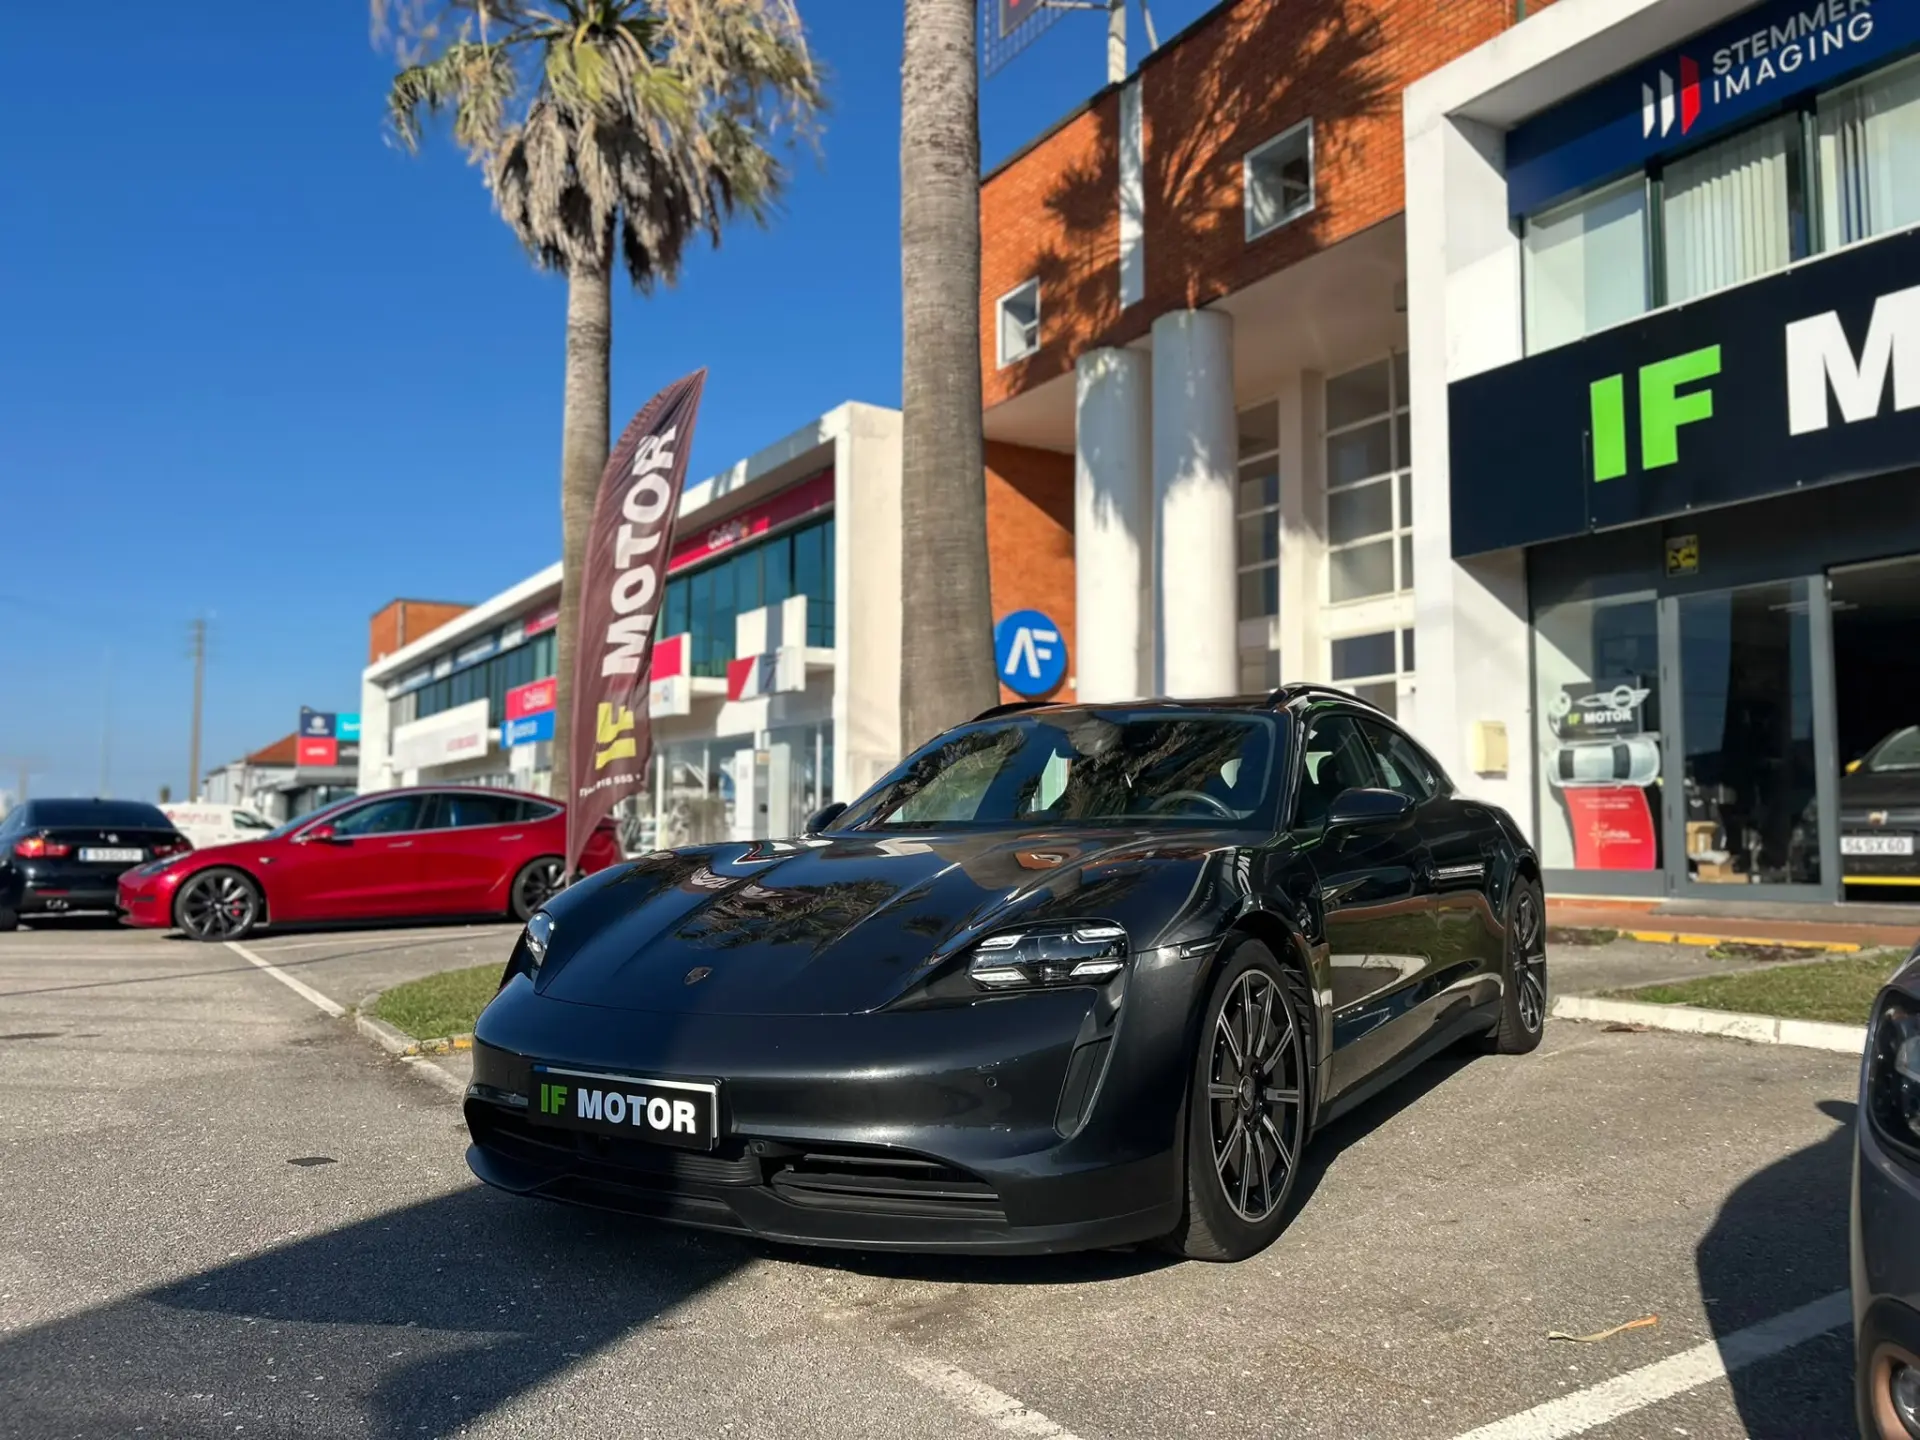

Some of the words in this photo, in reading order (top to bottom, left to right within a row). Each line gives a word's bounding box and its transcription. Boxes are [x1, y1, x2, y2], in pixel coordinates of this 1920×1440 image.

[1713, 12, 1874, 104] IMAGING
[1590, 344, 1722, 482] IF
[601, 424, 677, 677] MOTOR
[1004, 626, 1058, 679] AF
[595, 702, 637, 770] IF
[1583, 710, 1633, 725] MOTOR
[540, 1083, 568, 1115] IF
[577, 1088, 697, 1135] MOTOR
